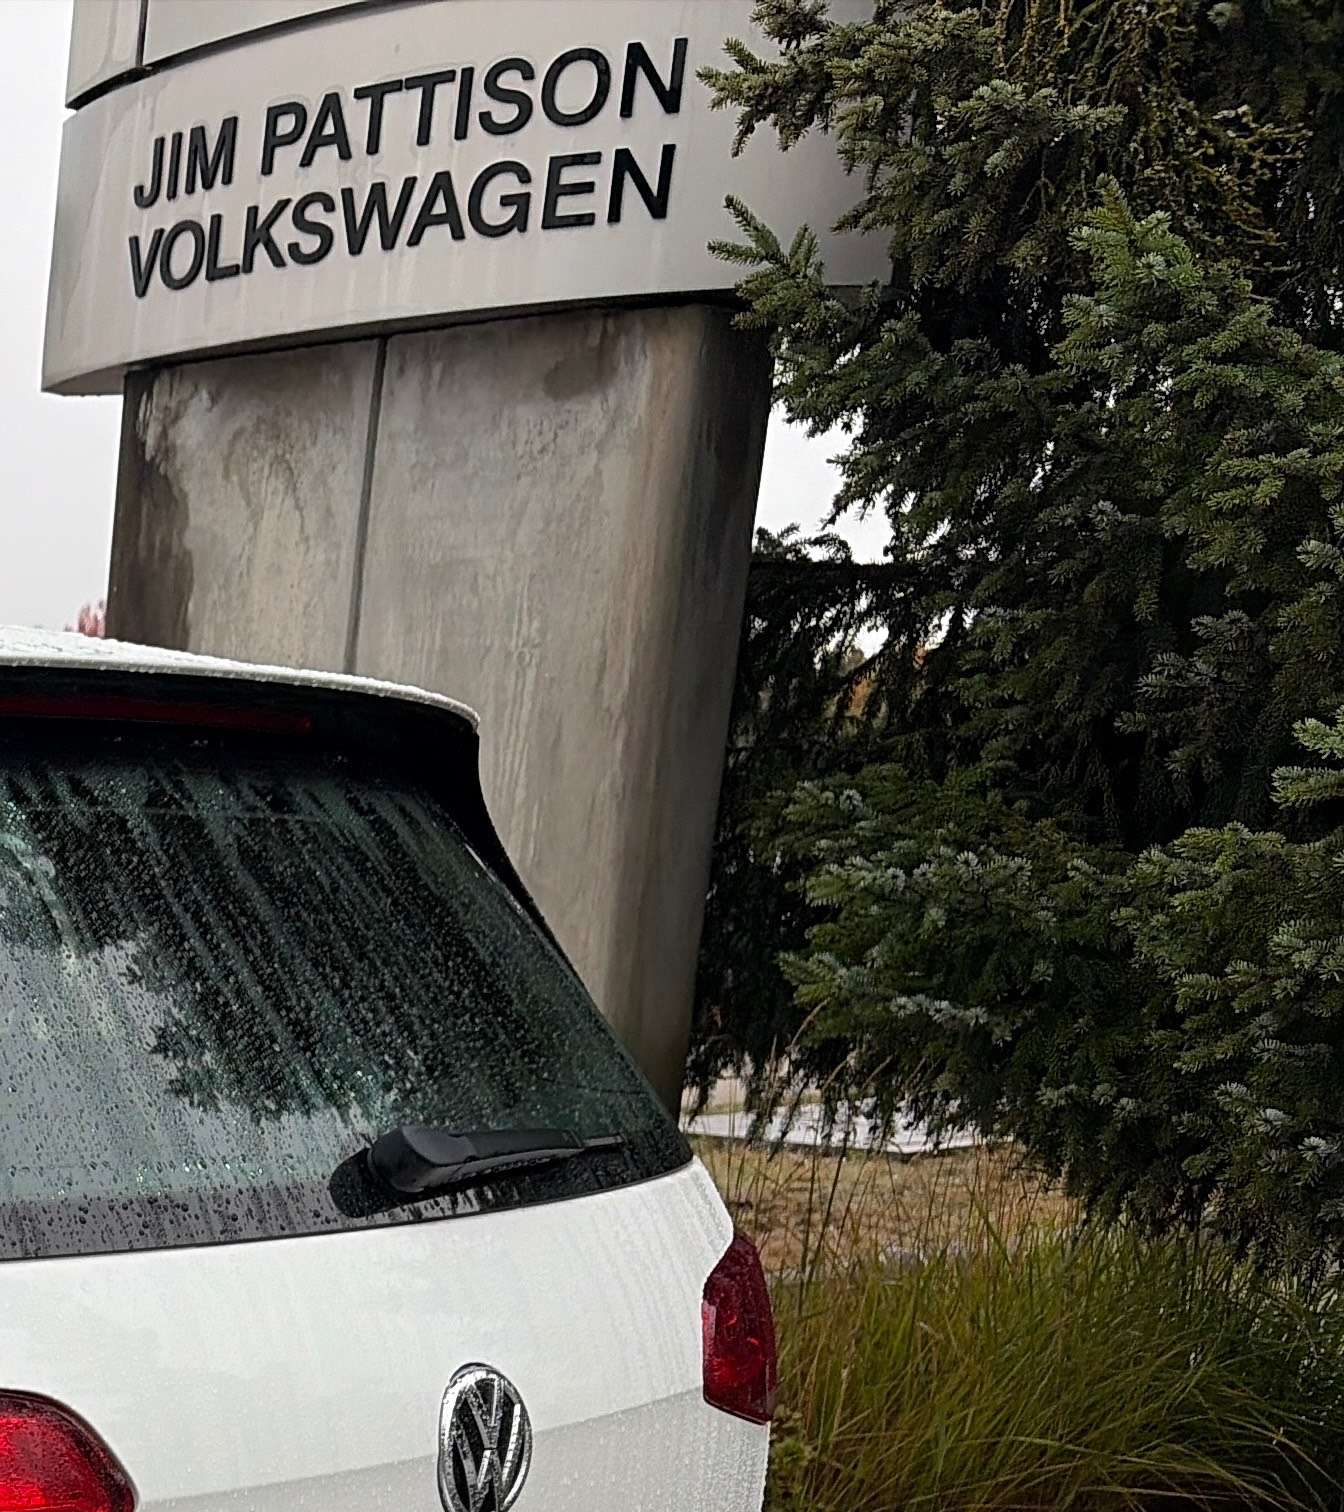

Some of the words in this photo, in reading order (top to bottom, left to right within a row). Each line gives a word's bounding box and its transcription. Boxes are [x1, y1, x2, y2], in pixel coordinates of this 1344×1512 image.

[134, 115, 238, 209] JIM
[260, 37, 689, 176] PATTISON
[128, 143, 677, 298] VOLKSWAGEN
